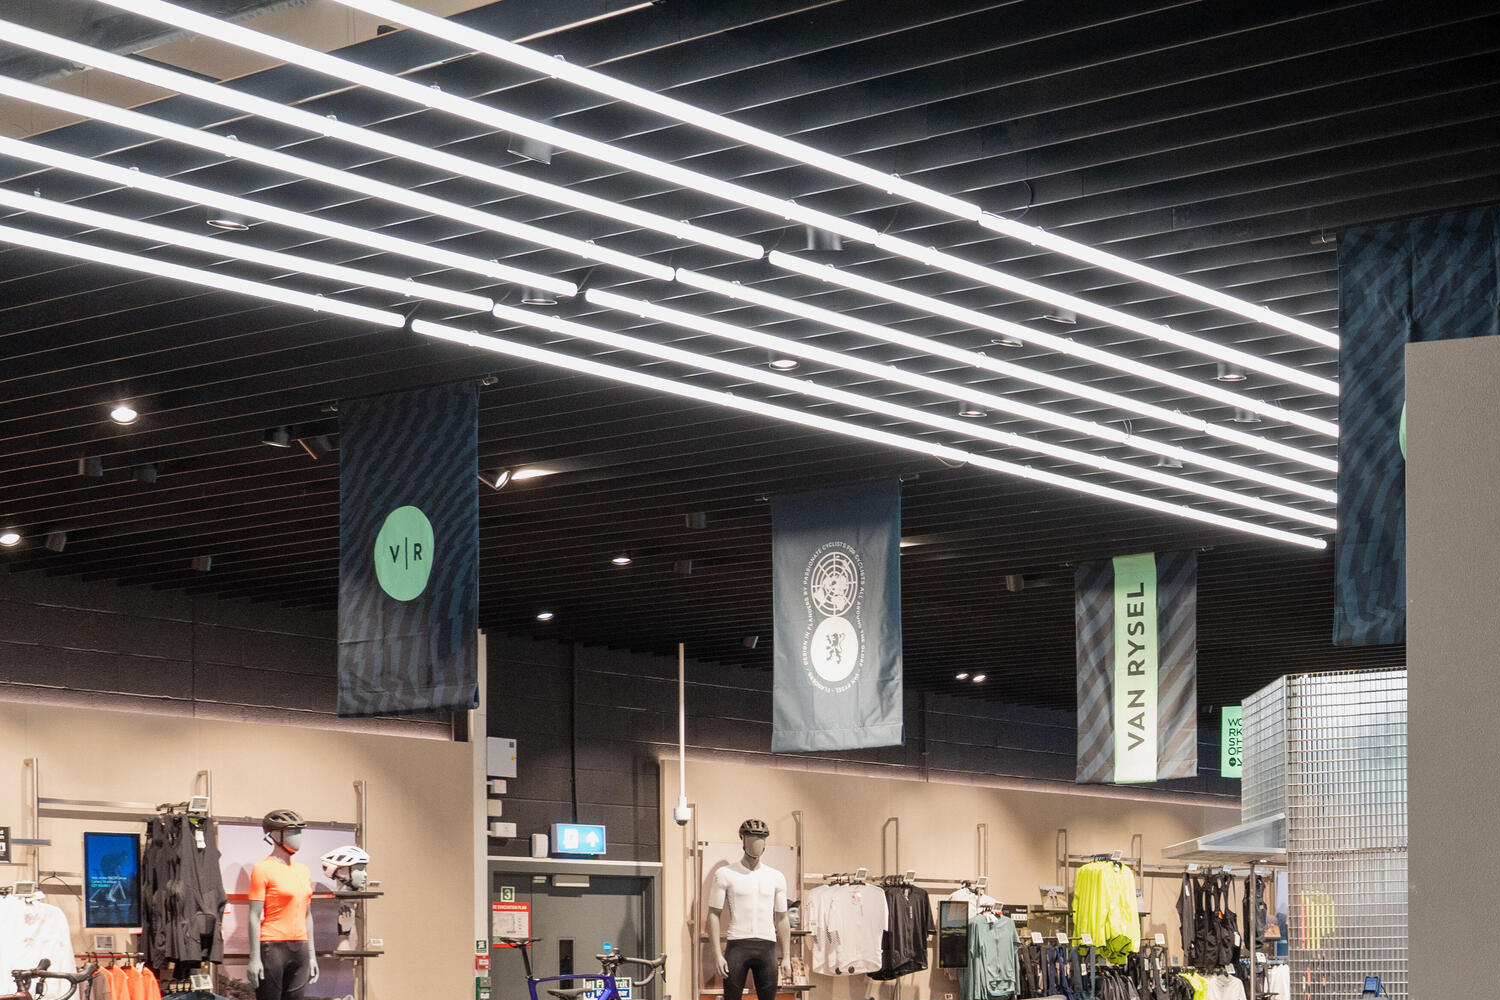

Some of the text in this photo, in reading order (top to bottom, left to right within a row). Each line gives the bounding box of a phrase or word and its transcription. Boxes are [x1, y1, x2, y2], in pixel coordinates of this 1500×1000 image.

[1126, 582, 1146, 752] VAN RYSEL
[504, 889, 511, 900] 3
